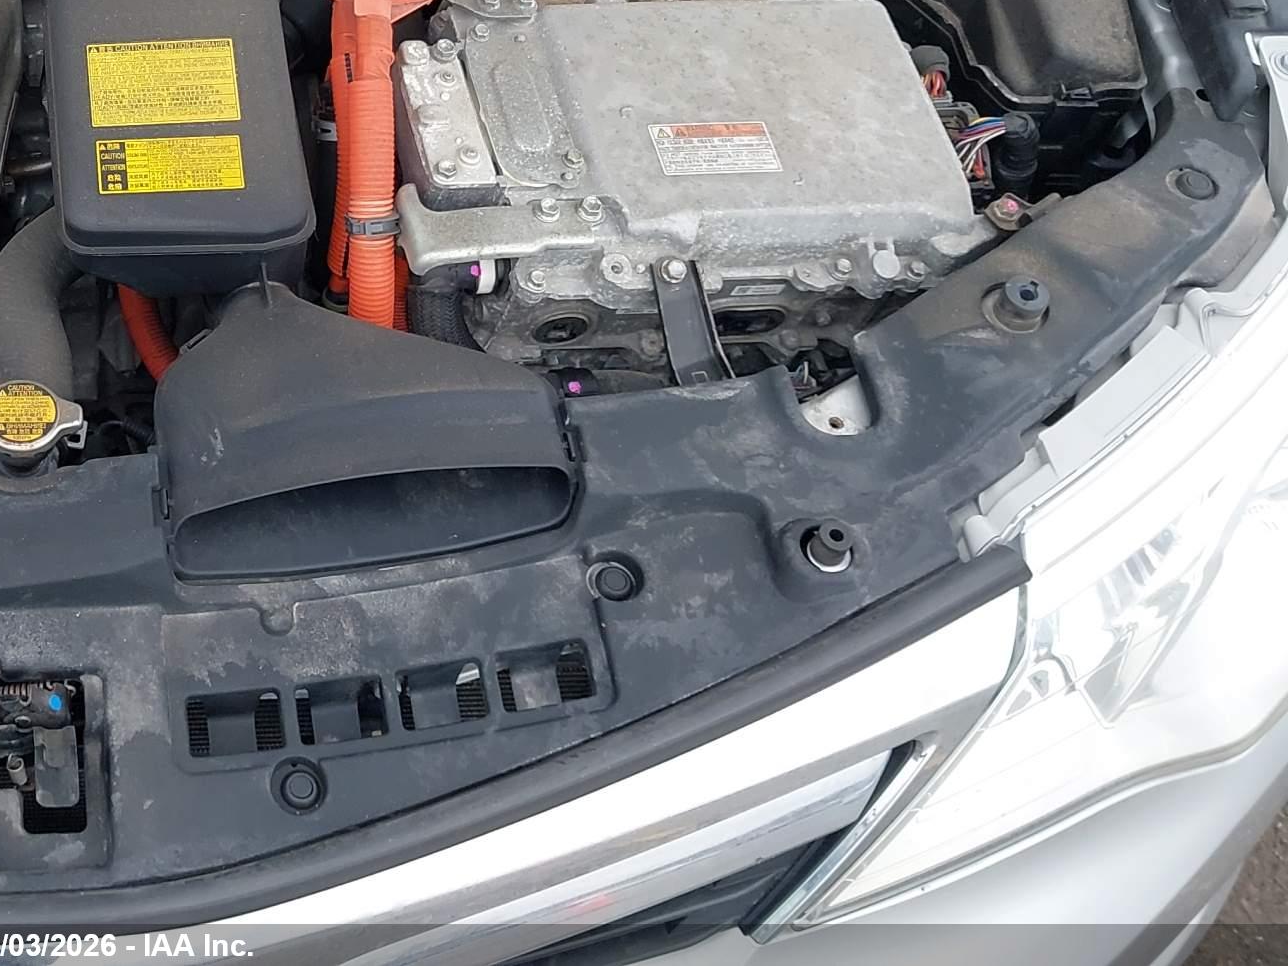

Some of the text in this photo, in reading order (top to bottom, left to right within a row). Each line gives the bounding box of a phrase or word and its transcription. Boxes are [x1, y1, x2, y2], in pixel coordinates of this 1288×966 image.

[114, 43, 148, 52] CAUTION
[149, 41, 190, 50] ATTENTION
[100, 152, 125, 160] CAUTION
[102, 163, 126, 171] ATTENTION
